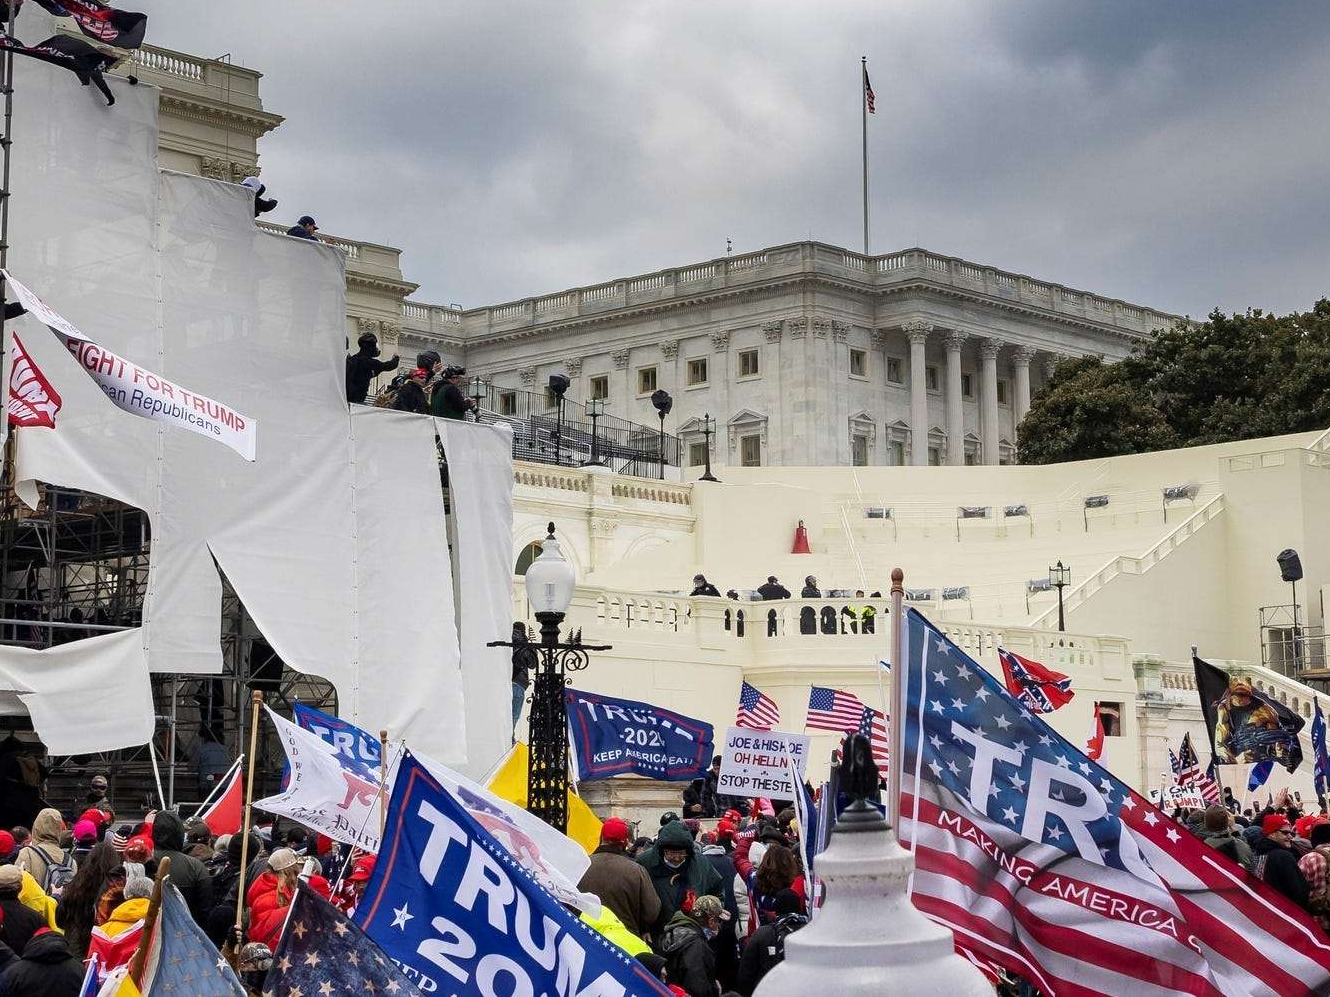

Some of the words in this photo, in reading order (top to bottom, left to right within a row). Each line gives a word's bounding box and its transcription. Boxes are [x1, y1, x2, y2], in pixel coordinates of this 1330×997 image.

[66, 338, 128, 379] FIGHT
[134, 366, 175, 399] FOR
[179, 387, 246, 433] TRUMP
[130, 389, 221, 435] Republicans
[308, 724, 382, 762] TRU
[619, 727, 666, 747] -202
[729, 737, 751, 750] JOE
[752, 738, 762, 750] &
[593, 749, 623, 763] KEEP
[734, 752, 751, 765] OH
[753, 755, 778, 768] HELL
[779, 758, 801, 770] N!
[720, 774, 750, 788] STOP
[751, 778, 771, 791] THE
[771, 780, 793, 793] STE
[1150, 782, 1196, 798] FGHT
[937, 810, 1037, 886] MAKING
[1041, 878, 1179, 938] AMERICA
[418, 800, 630, 997] TRUM
[417, 916, 534, 997] 20
